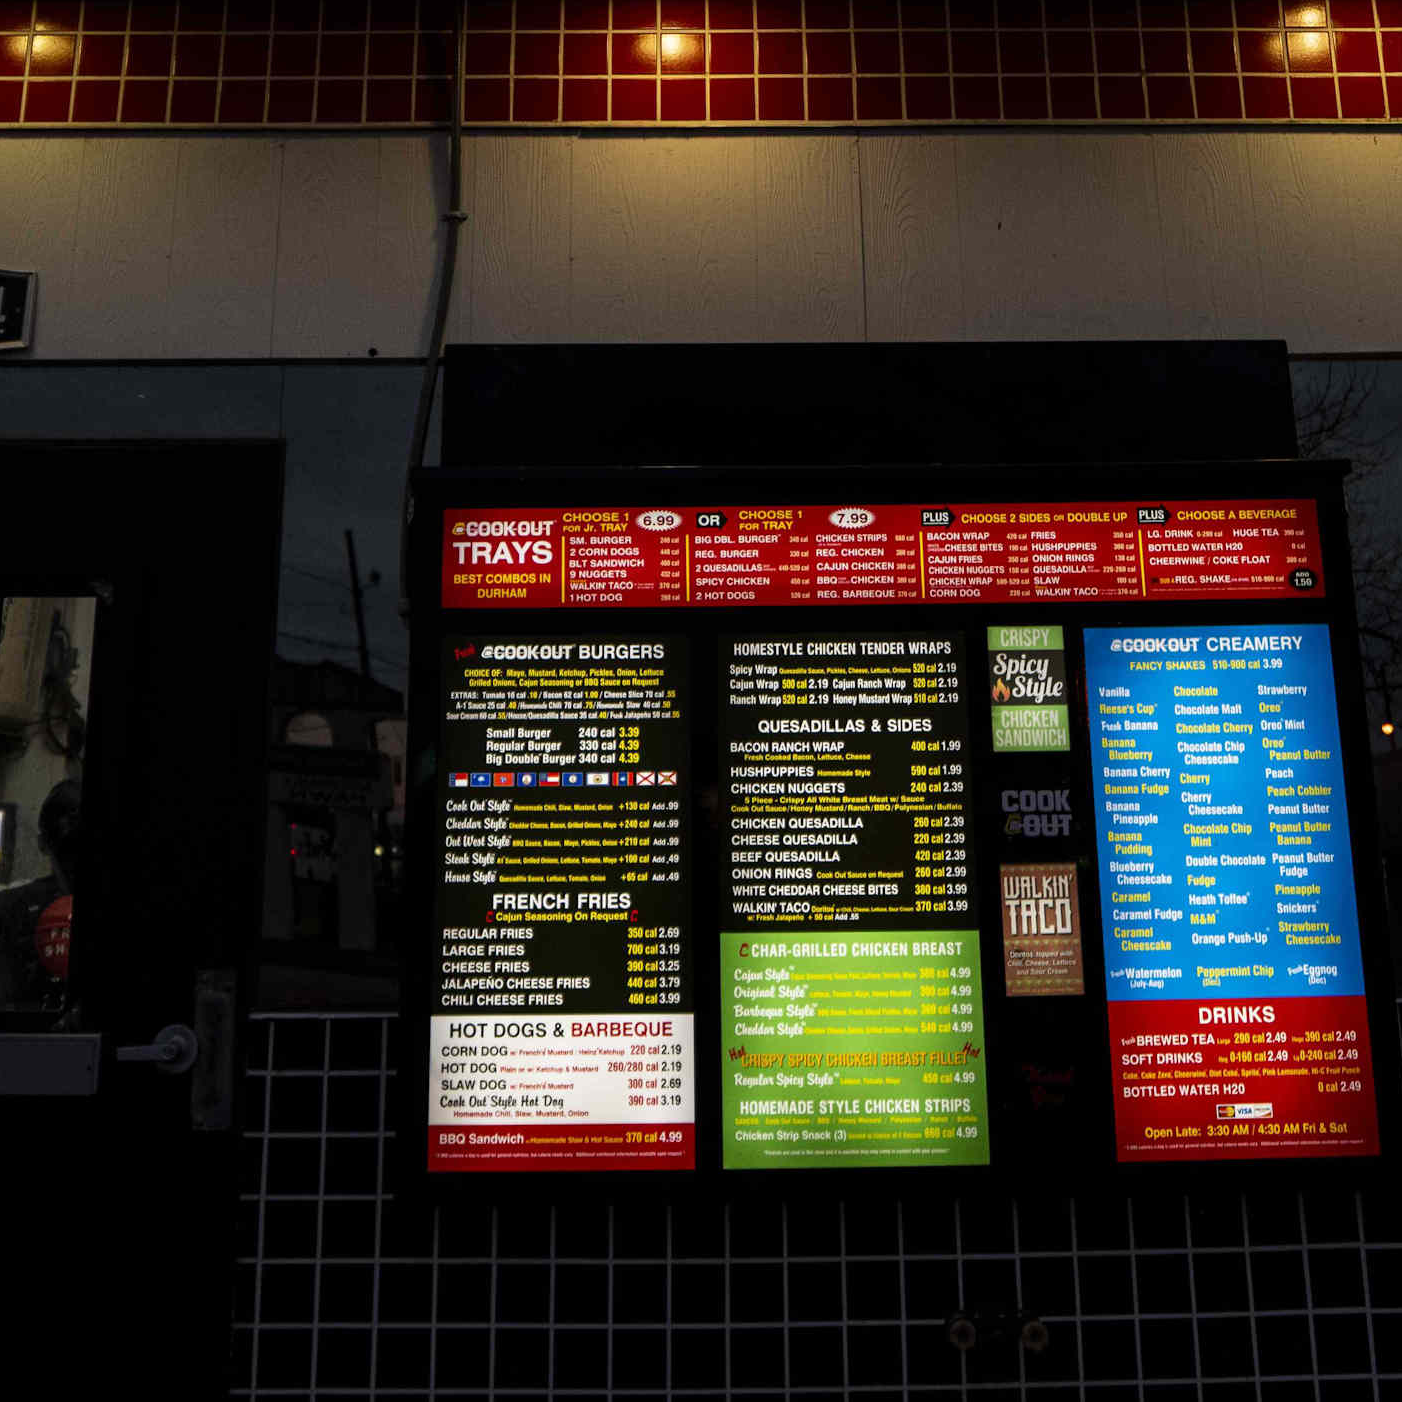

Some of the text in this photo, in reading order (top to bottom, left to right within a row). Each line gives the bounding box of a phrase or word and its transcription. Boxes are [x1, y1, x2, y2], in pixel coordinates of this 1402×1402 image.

[562, 512, 629, 522] CHOOSE 1
[698, 514, 721, 527] OR
[739, 510, 802, 522] CHOOSE 1
[837, 513, 868, 524] 7.99
[923, 511, 949, 524] PLUS
[961, 513, 1007, 524] CHOOSE
[1010, 513, 1016, 523] 2
[1019, 513, 1051, 523] SIDES
[1067, 512, 1110, 522] DOUBLE
[1113, 512, 1128, 522] UP
[1139, 509, 1165, 520] PLUS
[1177, 509, 1297, 521] CHOOSE A BEVERAGE
[643, 517, 674, 527] 6.99
[569, 536, 632, 545] SM. BURGER
[927, 532, 990, 541] BACON WRAP
[1031, 531, 1056, 540] FRIES
[453, 541, 553, 564] TRAYS
[570, 547, 640, 556] 2 CORN DOGS
[1031, 542, 1097, 551] HUSHPUPPIES
[1148, 543, 1223, 552] BOTTLED WATER
[569, 559, 644, 568] BLT SANDWICH
[1032, 554, 1094, 563] ONION RINGS
[454, 573, 551, 584] BEST COMBOS IN
[569, 569, 627, 579] 9 NUGGETS
[696, 577, 770, 586] SPICY CHICKEN
[477, 588, 527, 598] DURHAM
[570, 593, 623, 602] 1 HOT DOG
[1000, 629, 1049, 648] CRISPY
[1206, 636, 1303, 652] CREAMERY
[579, 644, 664, 659] BURGERS
[734, 641, 951, 656] HOMESTYLE CHICKEN TENDER WRAPS
[993, 654, 1049, 680] Spicy
[1130, 660, 1206, 670] FANCY SHAKES
[1263, 658, 1283, 669] 3.99
[1011, 676, 1063, 704] Style
[1099, 687, 1130, 697] Vanilla
[1173, 686, 1218, 697] Chocolate
[1257, 684, 1307, 696] Strawberry
[1001, 709, 1059, 728] CHICKEN
[758, 718, 932, 733] QUESADILLAS & SIDES
[486, 726, 640, 741] Small Burger 240 cal 3.39
[996, 728, 1066, 747] SANDWICH
[486, 740, 640, 753] Regular Burger 330 cal 4.39
[730, 740, 961, 753] BACON RANCH WRAP 400 cal 1.99
[1109, 750, 1153, 762] Blueberry
[1001, 789, 1071, 812] COOK
[1022, 814, 1072, 837] OUT
[731, 834, 858, 846] CHEESE QUESADILLA
[1004, 875, 1073, 899] WALKIN'
[1275, 884, 1321, 897] Pineapple
[493, 893, 631, 910] FRENCH FRIES
[1112, 891, 1151, 903] Caramel
[1277, 902, 1318, 914] Snickers
[1005, 899, 1073, 936] TACO
[443, 927, 680, 939] REGULAR FRIES 350 cal 2.69
[751, 942, 962, 958] CHAR-GRILLED CHICKEN BREAST
[950, 967, 971, 978] 4.99
[1125, 966, 1182, 980] Watermelon
[1303, 964, 1337, 978] Eggnog
[1199, 1006, 1275, 1024] DRINKS
[450, 1021, 673, 1038] HOT DOGS & BARBEQUE
[1136, 1033, 1215, 1046] BREWED TEA
[741, 1051, 969, 1068] CRISPY SPICY CHICKEN BREAST FILLET
[1122, 1052, 1203, 1065] SOFT DRINKS
[1123, 1085, 1176, 1098] BOTTLED
[1179, 1084, 1220, 1096] WATER
[740, 1098, 970, 1115] HOMEMADE STYLE CHICKEN STRIPS
[659, 1131, 682, 1142] 4.99
[1145, 1124, 1249, 1139] Open Late: 3:30 AM
[439, 1133, 466, 1144] BBQ
[469, 1133, 524, 1144] Sandwich
